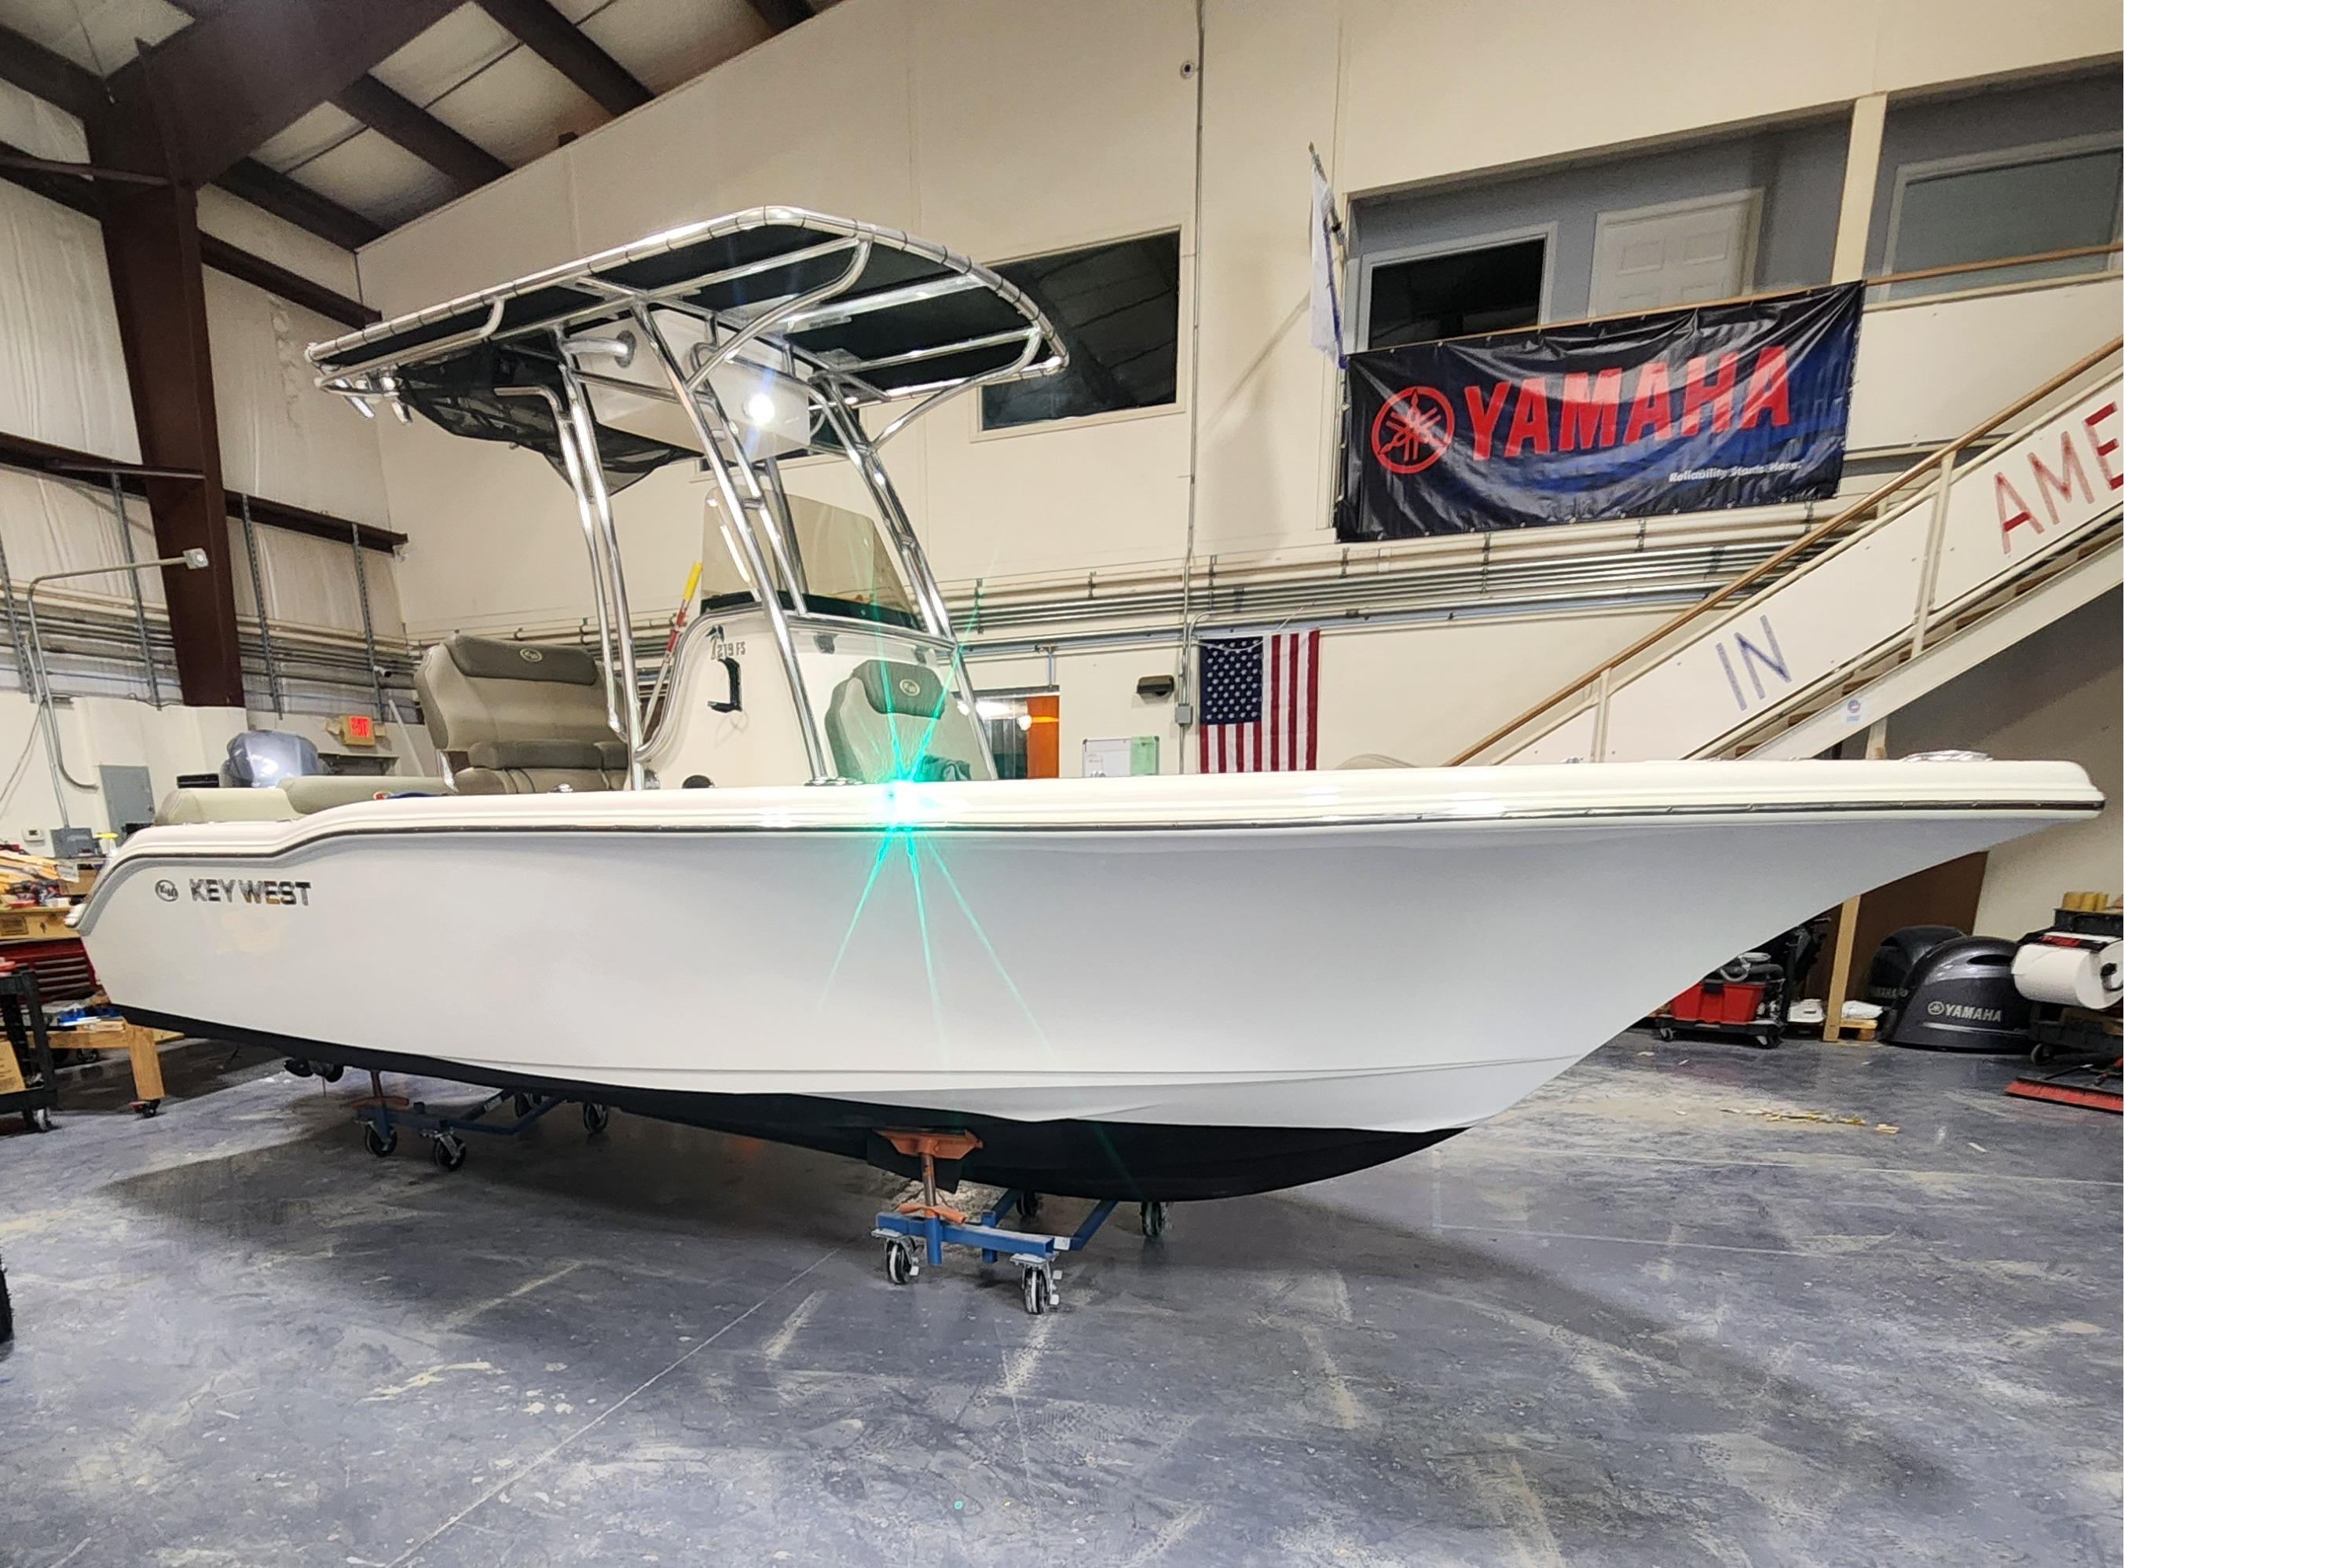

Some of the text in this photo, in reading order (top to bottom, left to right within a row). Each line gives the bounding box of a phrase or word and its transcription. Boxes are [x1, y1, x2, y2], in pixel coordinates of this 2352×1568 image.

[1464, 346, 1790, 461] YAMAHA
[1668, 467, 1727, 482] Reliability
[1729, 465, 1764, 477] Starts
[1716, 401, 2123, 711] IN AME
[736, 641, 746, 656] FS
[189, 878, 311, 906] KEY WEST
[1945, 1004, 2002, 1022] YAMAHA
